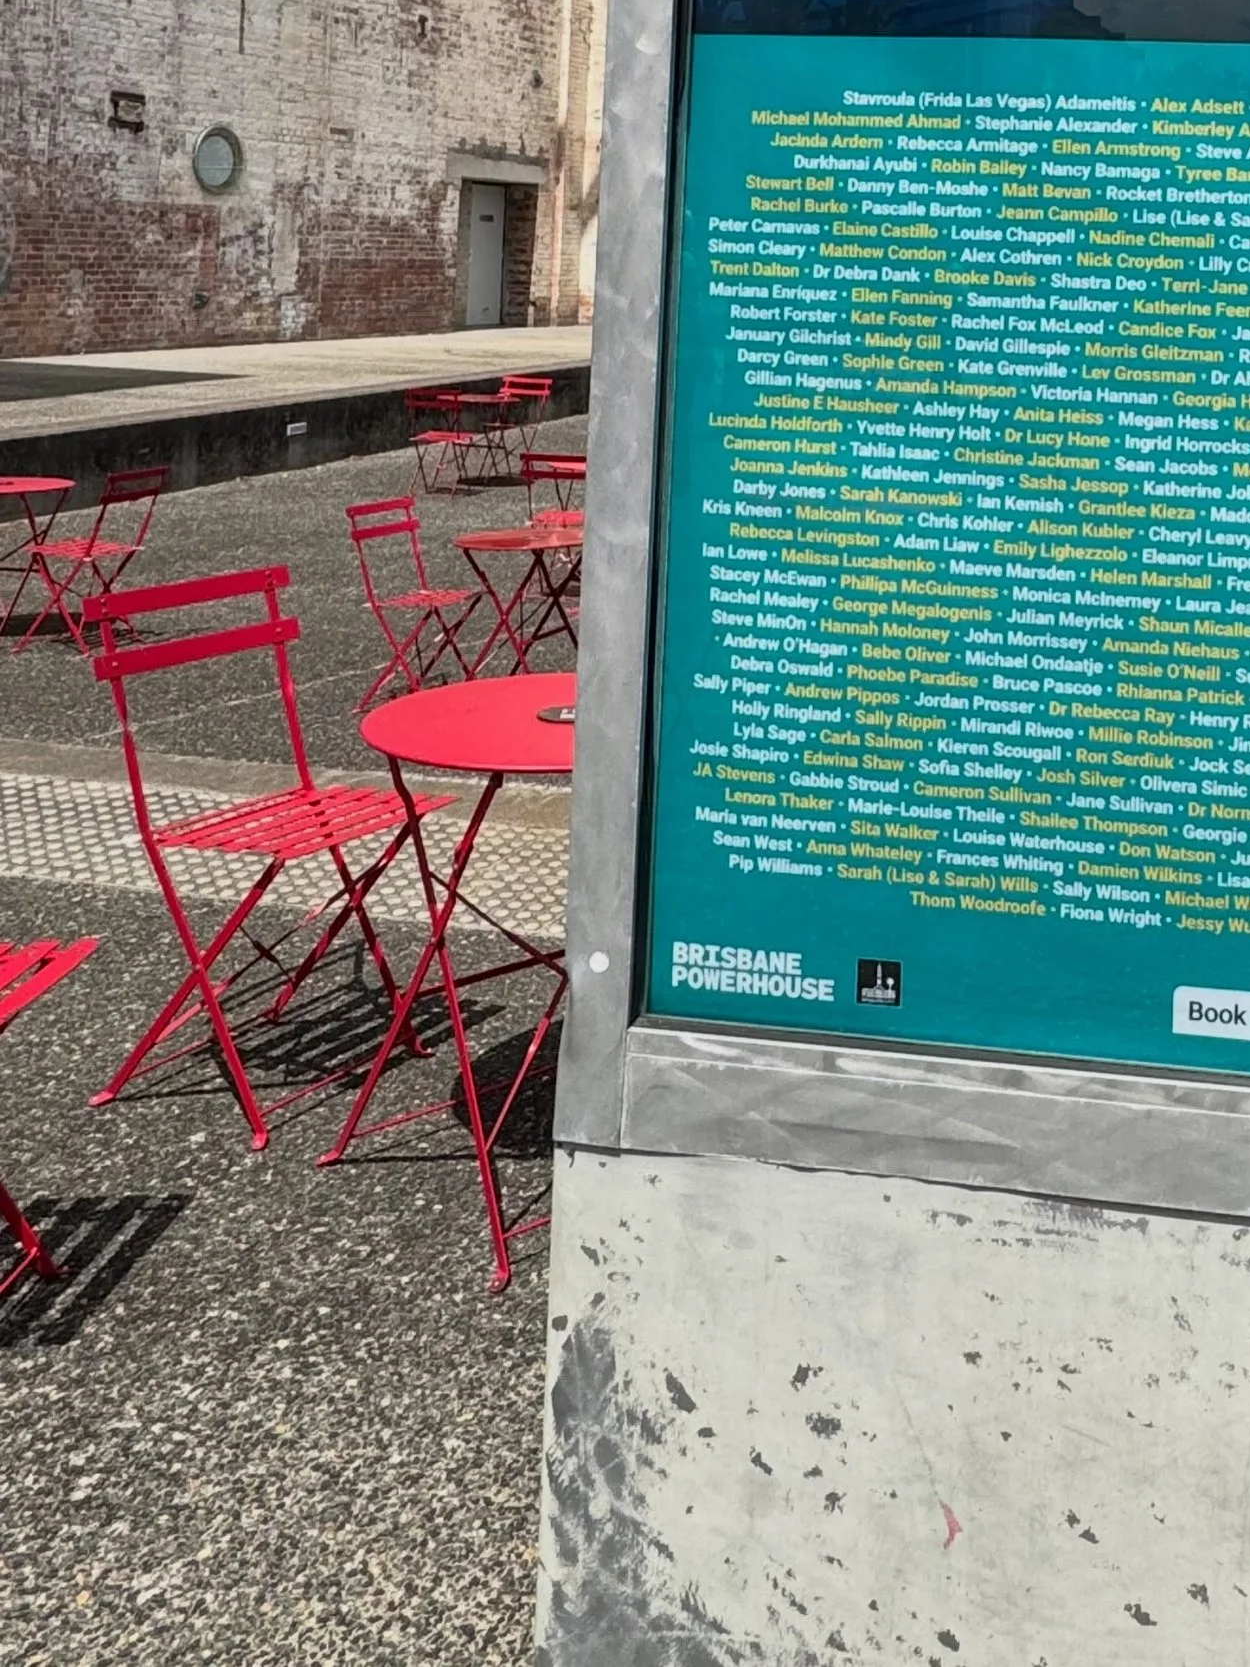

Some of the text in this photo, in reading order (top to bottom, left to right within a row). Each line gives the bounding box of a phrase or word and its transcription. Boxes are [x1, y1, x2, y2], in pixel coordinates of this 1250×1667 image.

[843, 90, 915, 106] Stavroula
[919, 92, 962, 110] (Frida
[966, 93, 992, 108] Las
[997, 93, 1051, 112] Vegas)
[1055, 94, 1136, 111] Adameitis
[1151, 97, 1186, 113] Alex
[1191, 99, 1244, 115] Adsett
[746, 174, 802, 190] Stewart
[806, 176, 834, 191] Bell
[848, 177, 895, 197] Danny
[899, 179, 988, 196] Ben-Moshe
[1002, 182, 1038, 198] Matt
[1043, 183, 1091, 199] Bevan
[1106, 185, 1162, 202] Rocket
[711, 260, 749, 275] Trent
[752, 261, 799, 277] Dalton
[813, 264, 831, 278] Dr
[834, 265, 878, 281] Debra
[882, 266, 920, 282] Dank
[934, 268, 989, 285] Brooke
[994, 270, 1036, 287] Davis
[1051, 273, 1111, 290] Shastra
[1116, 275, 1146, 291] Deo
[1162, 277, 1248, 295] Terri-Jane
[738, 348, 780, 367] Darcy
[784, 350, 828, 366] Green
[843, 353, 895, 372] Sophie
[898, 355, 944, 372] Green
[958, 358, 993, 375] Kate
[997, 360, 1067, 378] Grenville
[1082, 365, 1110, 380] Lev
[1114, 365, 1196, 384] Grossman
[1211, 370, 1230, 385] Dr
[734, 479, 776, 500] Darby
[780, 482, 826, 500] Jones
[840, 485, 885, 503] Sarah
[887, 488, 962, 507] Kanowski
[977, 493, 1001, 509] Ian
[1005, 495, 1063, 513] Kemish
[1079, 499, 1146, 518] Grantlee
[712, 609, 753, 627] Steve
[757, 613, 806, 631] MinOn
[820, 618, 879, 636] Hannah
[882, 622, 950, 644] Moloney
[964, 628, 1003, 645] John
[1008, 631, 1087, 654] Morrissey
[1103, 637, 1169, 655] Amanda
[1173, 641, 1240, 660] Niehaus
[732, 699, 770, 720] Holly
[774, 703, 841, 724] Ringland
[856, 709, 893, 730] Sally
[897, 712, 946, 732] Rippin
[961, 717, 1021, 735] Mirandi
[1025, 721, 1073, 740] Riwoe
[1089, 726, 1133, 744] Millie
[1137, 729, 1213, 749] Robinson
[696, 806, 737, 825] Maria
[741, 814, 767, 827] van
[771, 814, 836, 833] Neerven
[851, 820, 881, 836] Sita
[885, 823, 939, 841] Walker
[954, 828, 1006, 846] Louise
[1010, 832, 1105, 854] Waterhouse
[1119, 841, 1151, 857] Don
[1155, 844, 1215, 863] Watson
[910, 891, 955, 908] Thom
[960, 895, 1046, 916] Woodroofe
[1061, 903, 1104, 921] Fiona
[1108, 907, 1161, 928] Wright
[1177, 914, 1224, 935] Jessy
[673, 941, 802, 974] BRISBANE
[672, 965, 834, 1001] POWERHOUSE
[1189, 1001, 1246, 1026] Book
